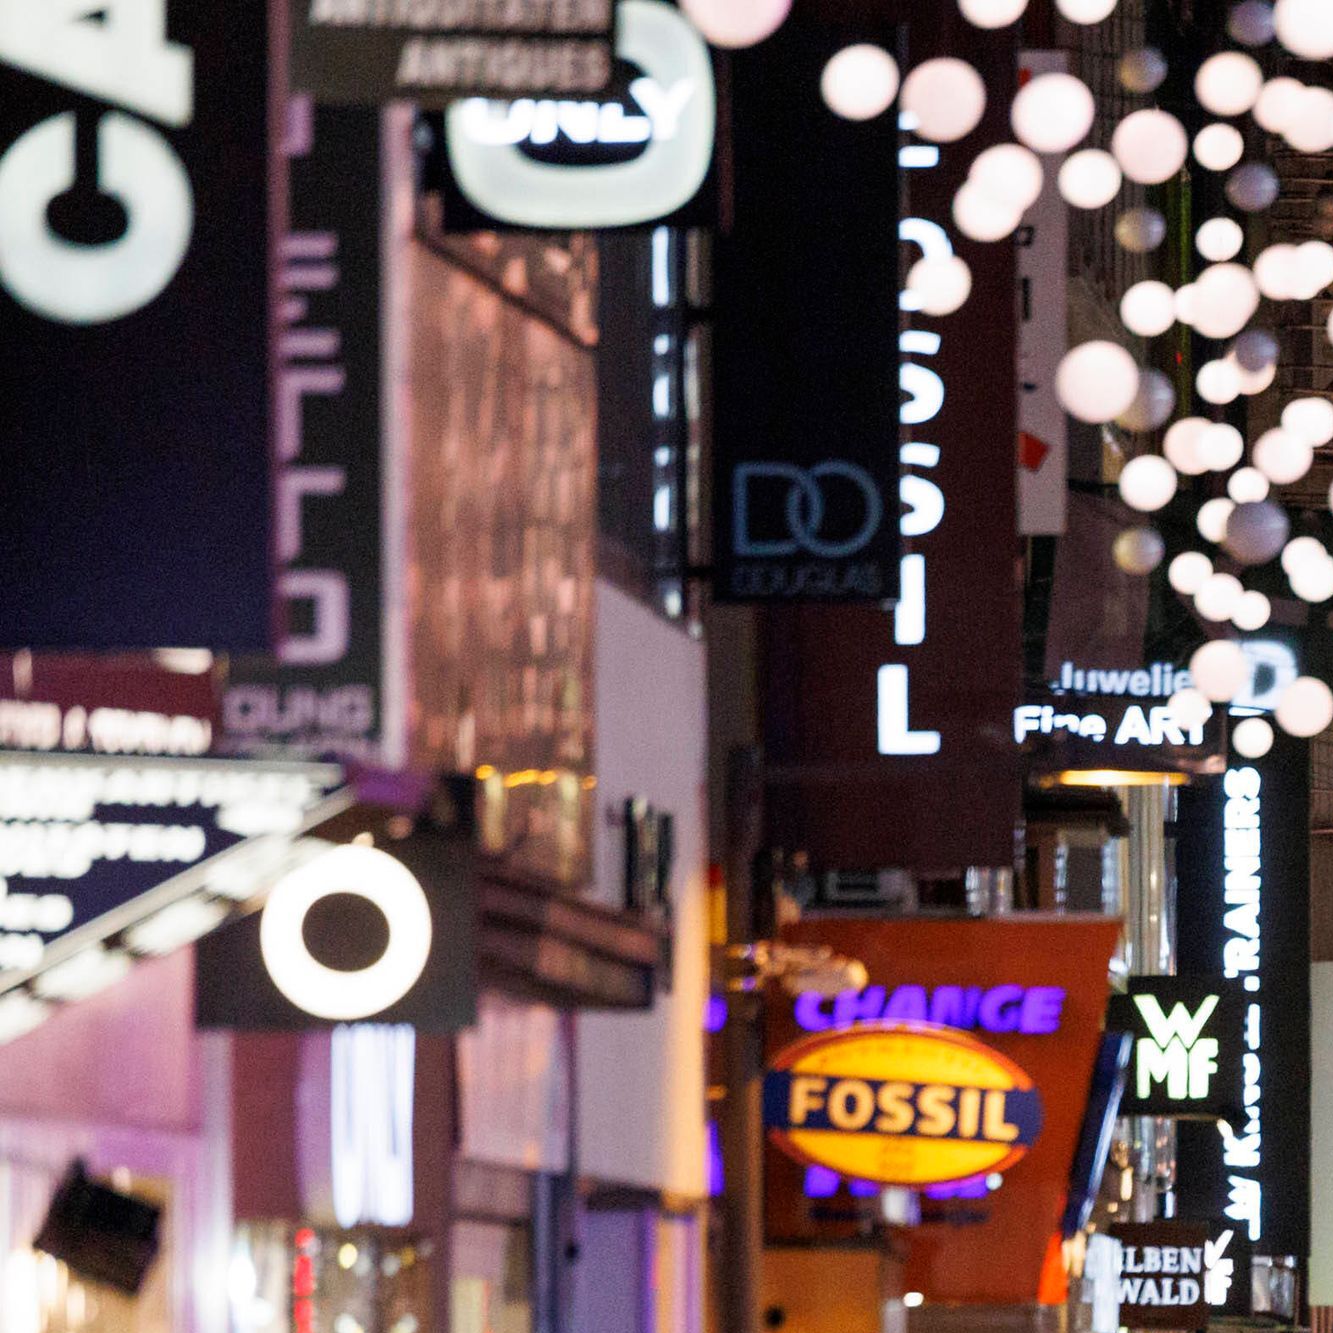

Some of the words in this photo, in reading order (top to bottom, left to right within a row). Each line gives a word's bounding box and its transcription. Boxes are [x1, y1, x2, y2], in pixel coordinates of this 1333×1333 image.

[1048, 660, 1196, 697] Juwelie
[794, 984, 1067, 1034] CHANGE
[1132, 993, 1220, 1099] WMF
[788, 1074, 1020, 1142] FOSSIL
[1121, 1247, 1203, 1274] LBEN
[1118, 1277, 1202, 1306] WALD
